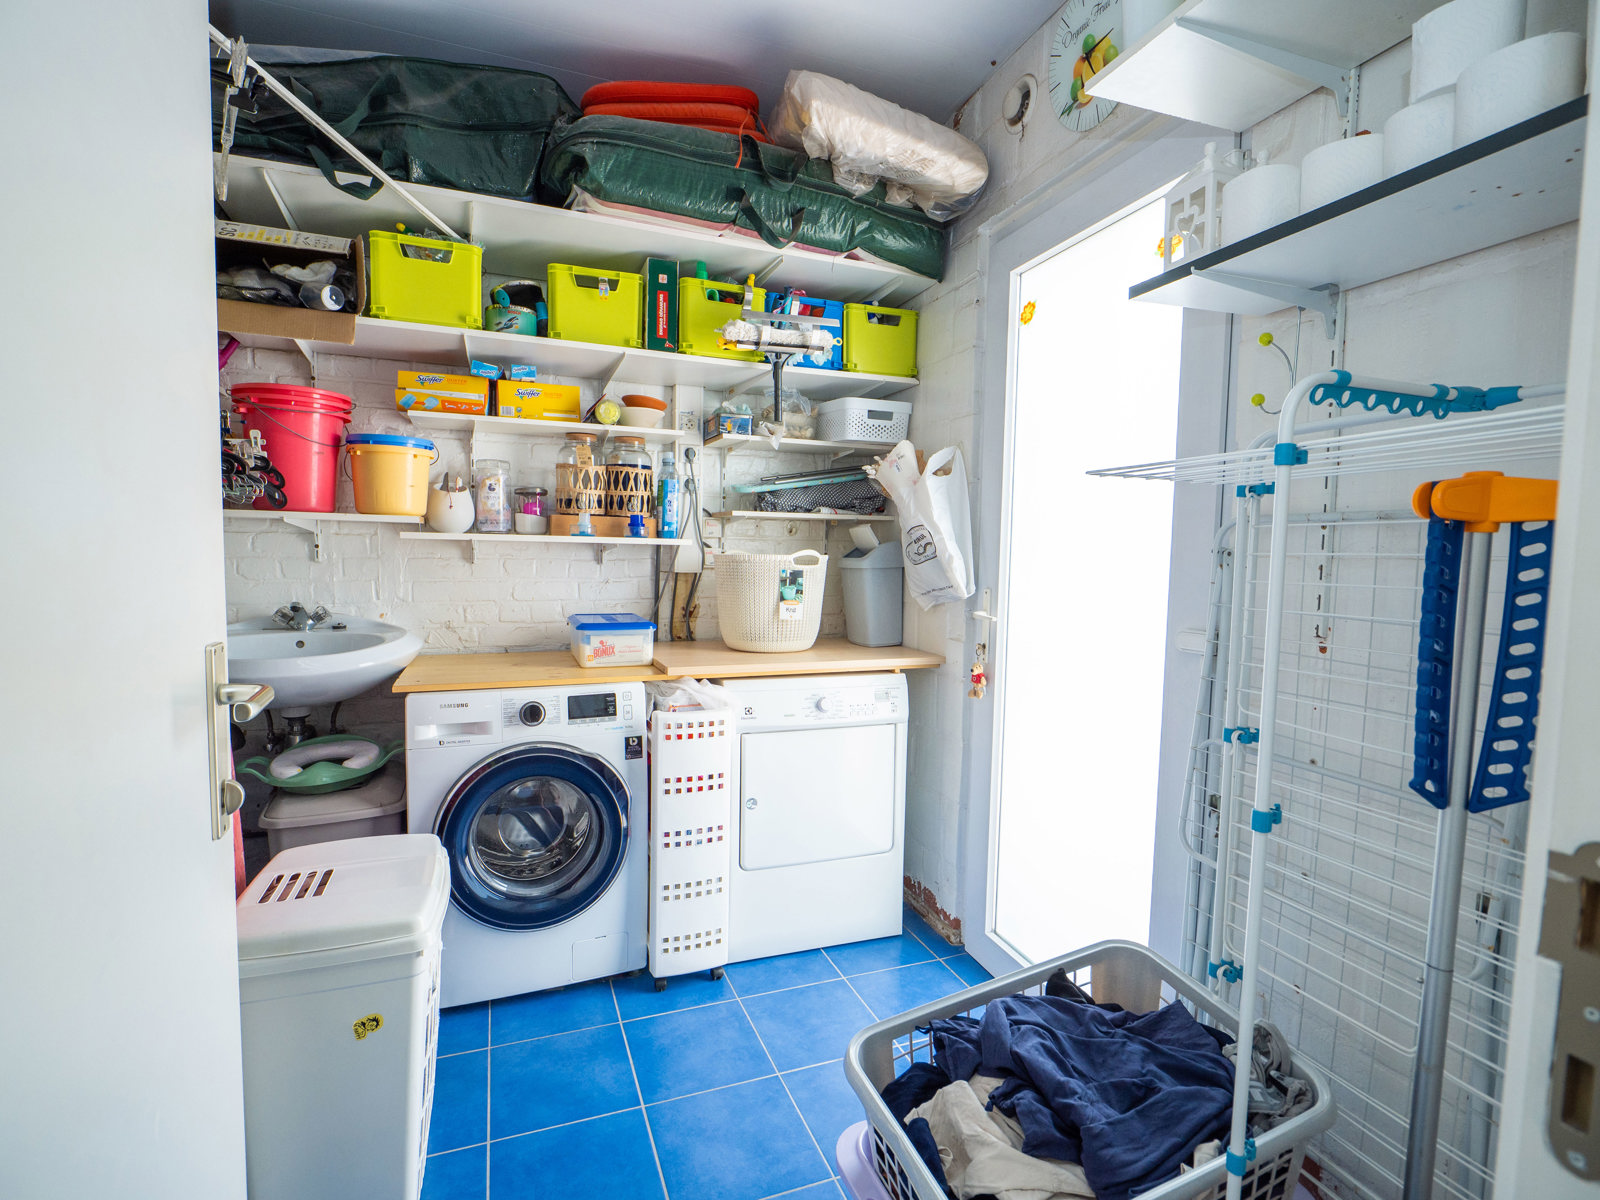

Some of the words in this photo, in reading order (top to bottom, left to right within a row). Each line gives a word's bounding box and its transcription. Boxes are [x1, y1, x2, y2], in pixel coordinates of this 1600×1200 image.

[1062, 18, 1090, 48] Organic
[415, 375, 445, 385] Swiffer
[514, 388, 541, 399] Swiffer
[593, 645, 616, 659] BONUX
